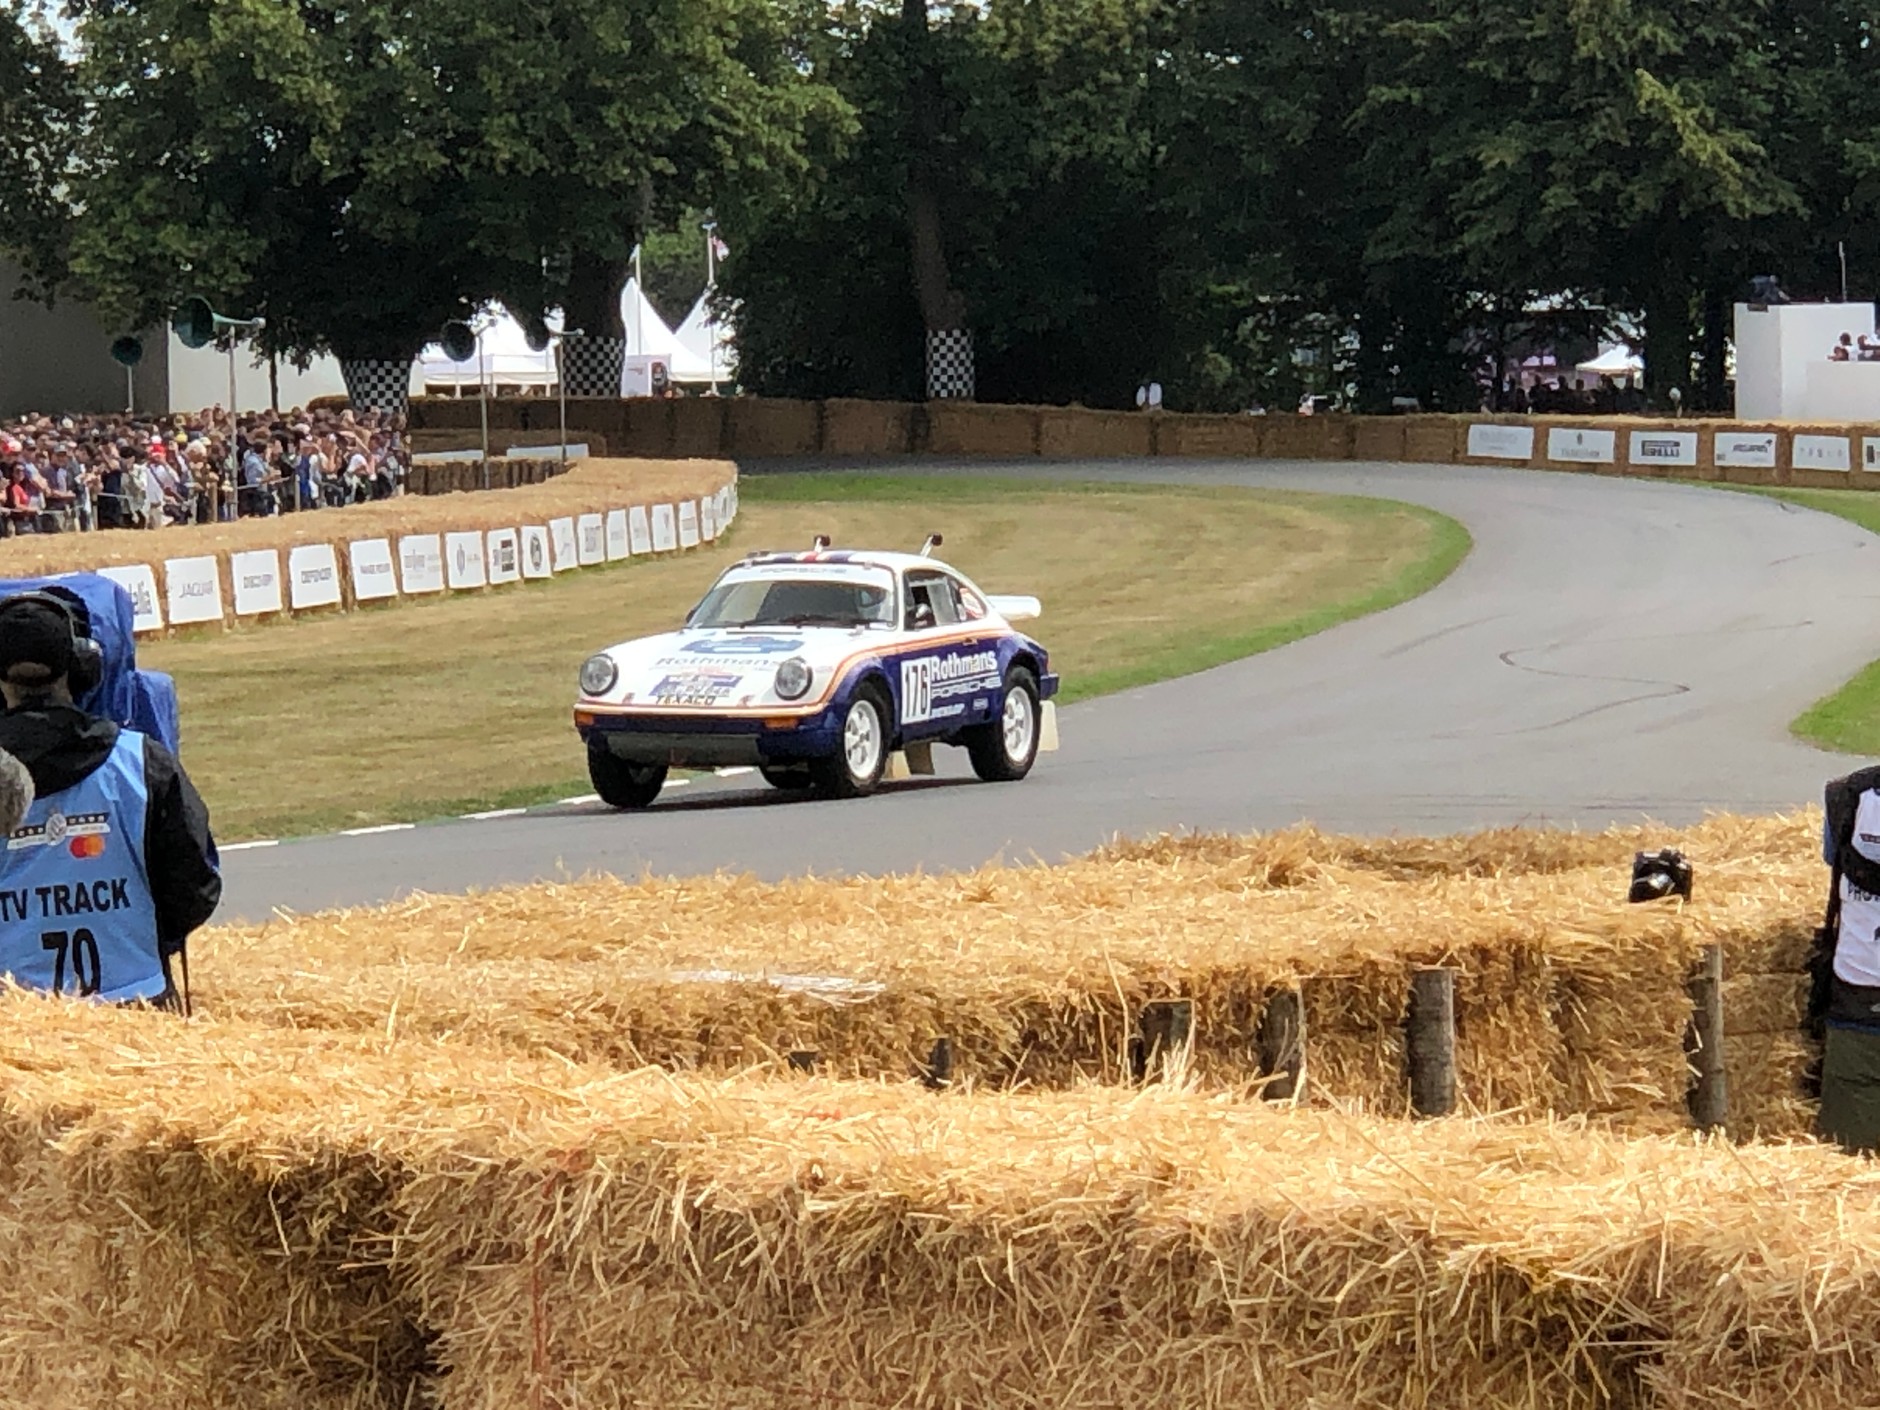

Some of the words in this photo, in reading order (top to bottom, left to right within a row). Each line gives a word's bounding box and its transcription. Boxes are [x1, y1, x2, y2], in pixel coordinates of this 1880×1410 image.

[931, 651, 998, 682] Rothmans
[655, 695, 717, 705] TEXACO
[905, 663, 928, 718] 176
[931, 676, 1002, 699] PORSCHE
[0, 888, 28, 922] TV
[35, 877, 131, 918] TRACK
[1848, 881, 1880, 902] PHO
[41, 927, 101, 998] 70
